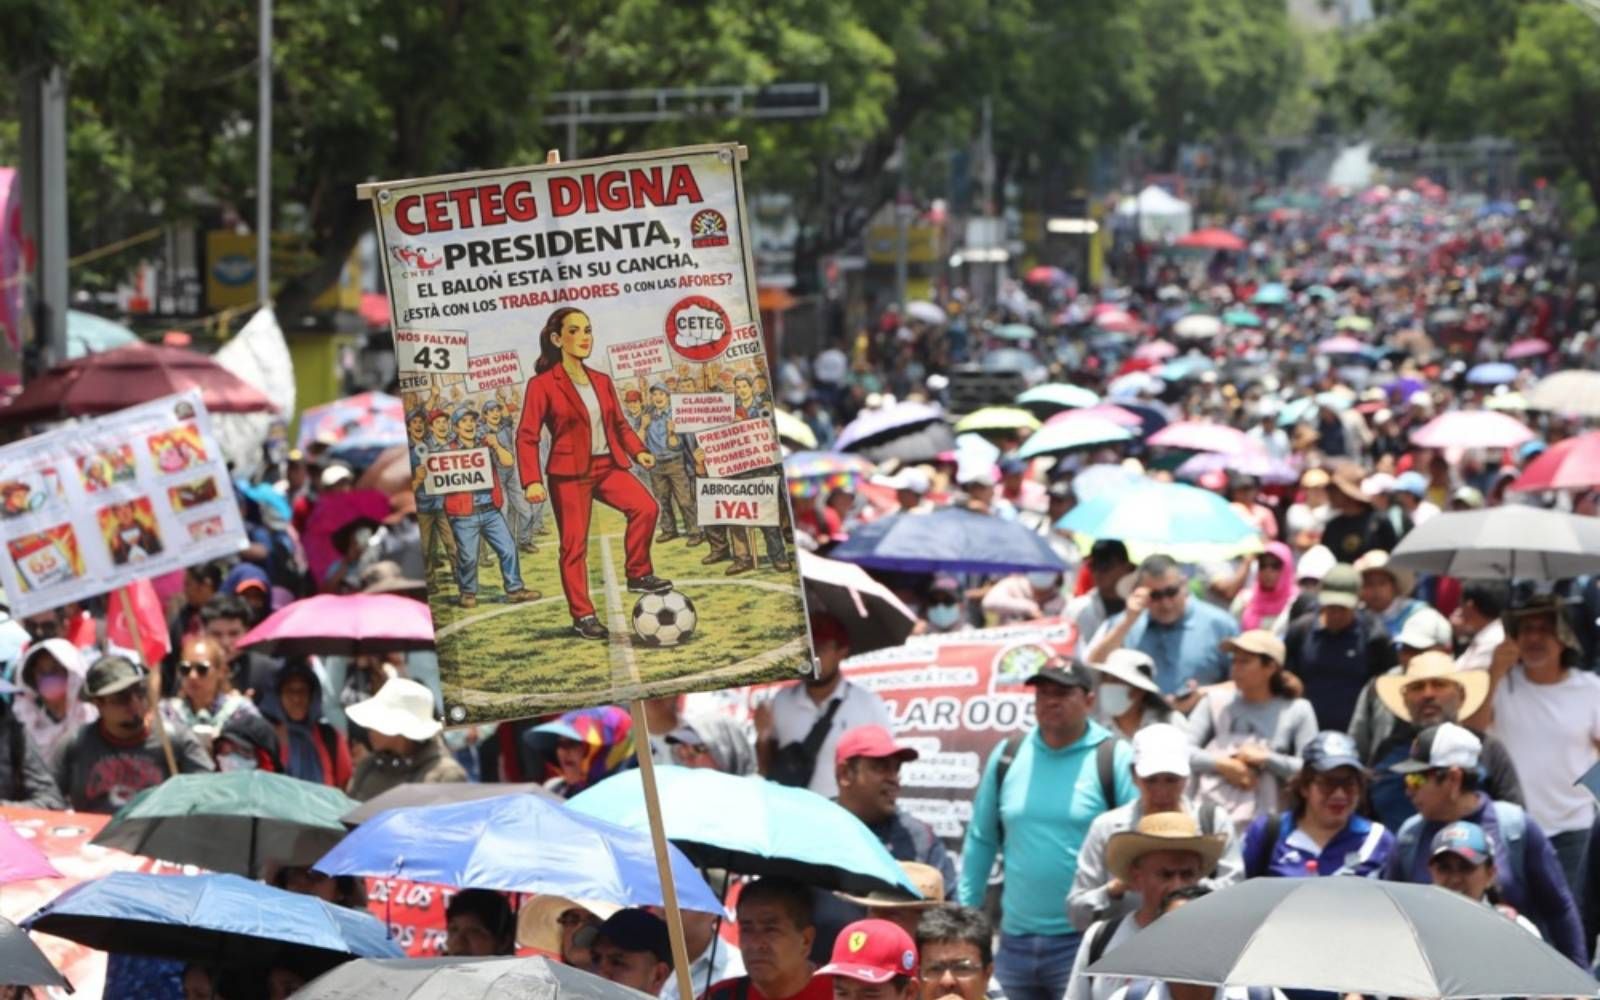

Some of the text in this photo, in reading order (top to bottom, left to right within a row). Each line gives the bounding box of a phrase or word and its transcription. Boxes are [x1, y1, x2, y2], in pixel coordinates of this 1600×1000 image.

[395, 164, 704, 236] CETEG DIGNA
[444, 220, 680, 270] PRESIDENTA,
[417, 283, 438, 298] EL
[558, 264, 582, 280] EN
[587, 262, 611, 277] SU
[616, 253, 699, 274] CANCHA,
[442, 302, 469, 316] CON
[473, 299, 497, 313] LOS
[499, 283, 620, 309] TRABAJADORES
[624, 284, 631, 293] O
[634, 281, 655, 292] CON
[658, 278, 677, 289] LAS
[678, 273, 733, 289] AFORES?
[677, 316, 724, 330] CETEG
[397, 332, 467, 345] NOS FALTAN
[414, 346, 450, 370] 43
[468, 352, 517, 368] POR UNA
[644, 348, 659, 356] LEY
[479, 377, 513, 390] DIGNA
[675, 405, 732, 415] SHEINBAUM
[682, 396, 724, 405] CLAUDIA
[698, 421, 769, 443] PRESIDENTA
[704, 432, 769, 454] CUMPLE TU
[427, 452, 485, 473] CETEG
[706, 442, 779, 466] PROMESA DE
[434, 471, 485, 488] DIGNA
[701, 479, 774, 496] ABROGACIÓN
[715, 500, 758, 519] ¡YA!
[369, 880, 395, 901] DE
[395, 883, 434, 907] LOS
